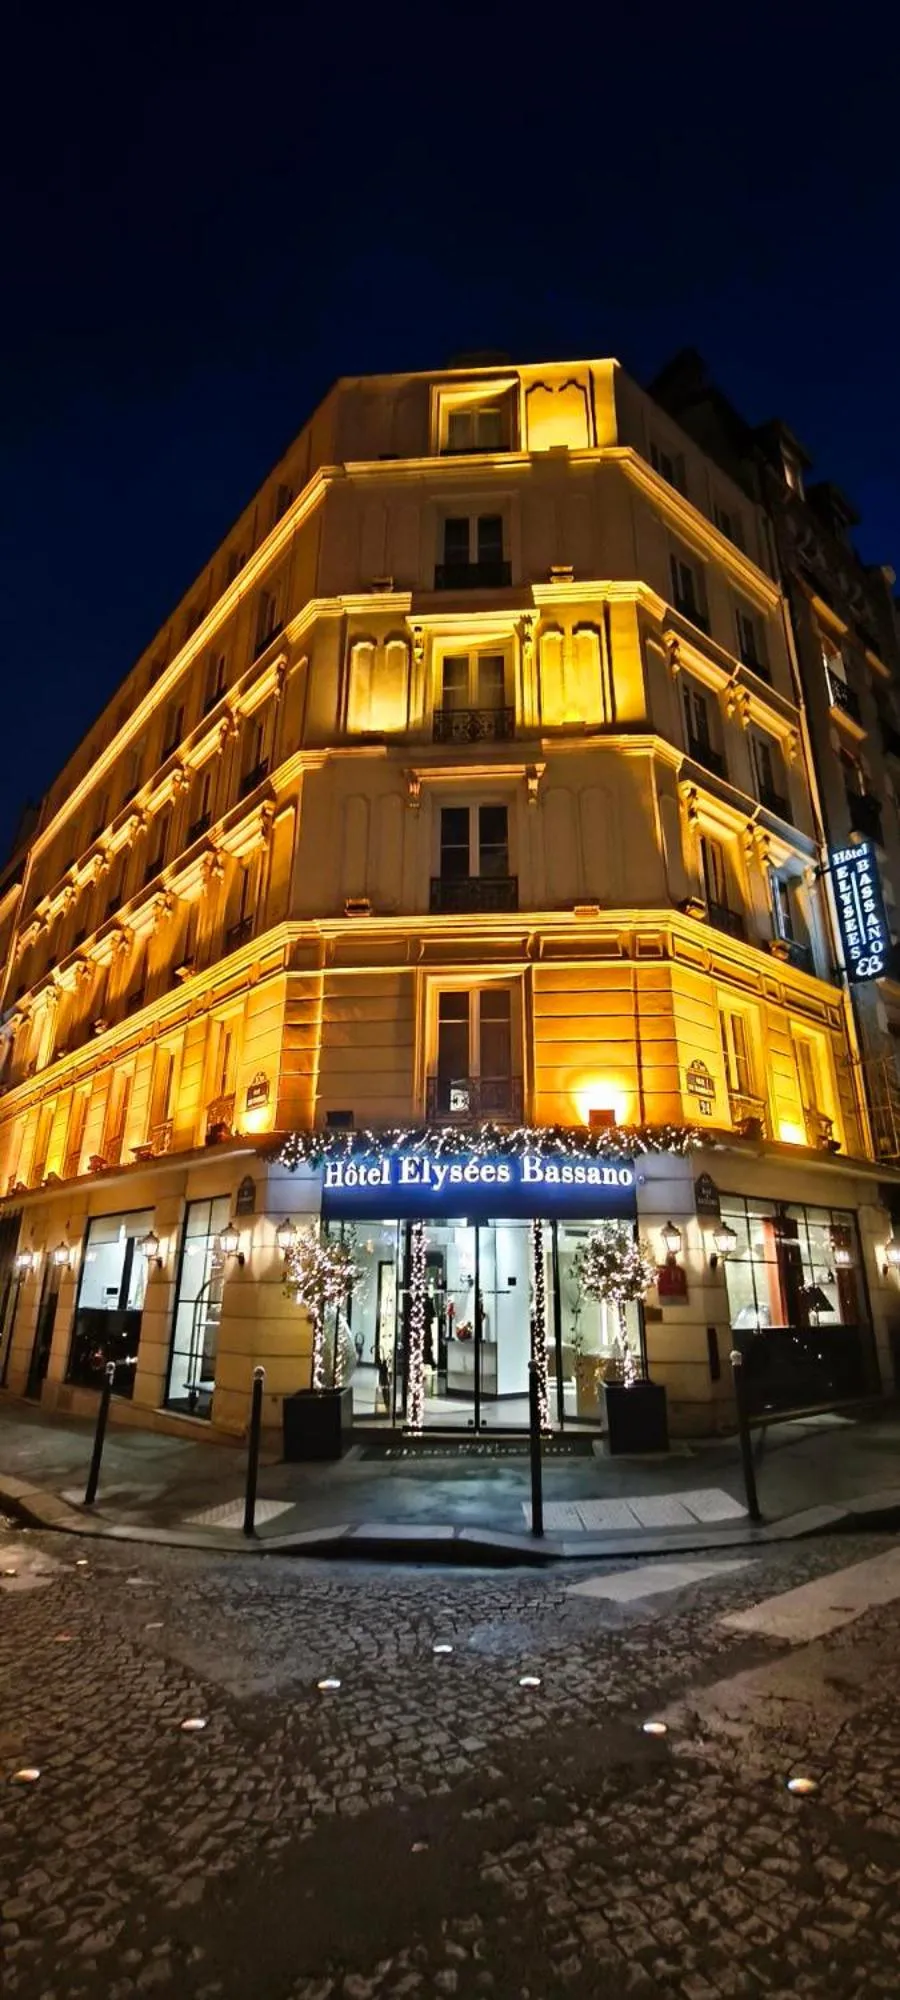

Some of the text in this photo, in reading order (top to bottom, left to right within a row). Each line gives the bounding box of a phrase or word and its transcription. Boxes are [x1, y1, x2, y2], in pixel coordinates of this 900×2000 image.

[832, 843, 868, 866] Hôtel
[836, 865, 861, 960] ELYSEES
[856, 859, 884, 954] BASSANO
[324, 1155, 633, 1191] Hôtel Elysées Bassano
